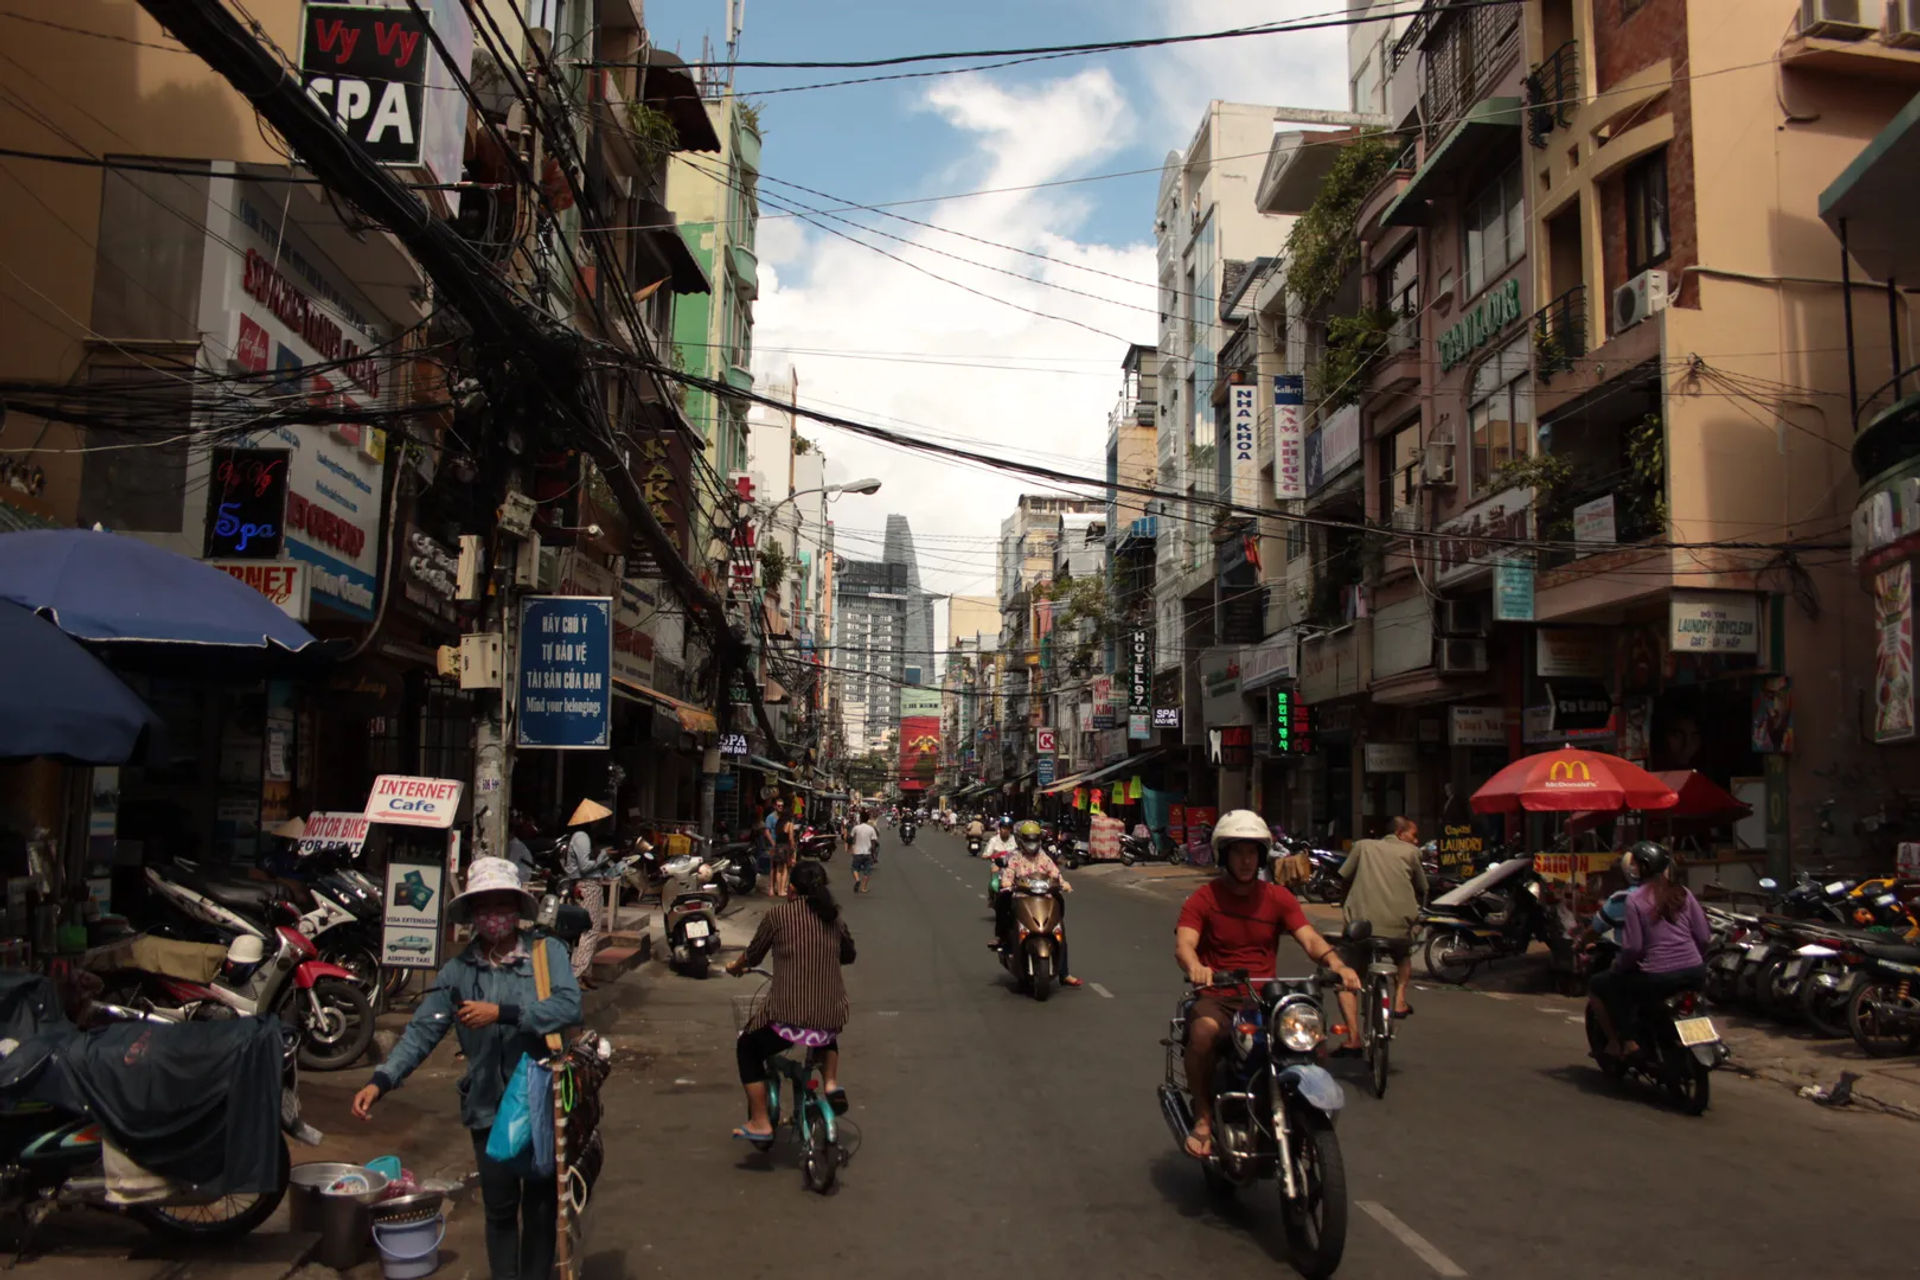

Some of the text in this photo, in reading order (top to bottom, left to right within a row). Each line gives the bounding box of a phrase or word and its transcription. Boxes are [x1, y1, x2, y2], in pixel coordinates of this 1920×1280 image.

[315, 19, 419, 67] Vy Vy
[1237, 390, 1252, 460] NHA KHOA
[215, 502, 277, 551] Spa
[562, 613, 578, 633] CHÚ
[581, 613, 587, 633] Ý
[527, 667, 601, 692] TÀI SẢN CỦA BẠN
[526, 697, 600, 717] Mind your belongings
[1096, 704, 1113, 715] KIM
[1156, 709, 1176, 718] SPA
[719, 733, 747, 746] SPA
[378, 780, 457, 800] INTERNET
[1545, 780, 1597, 788] McDonald's
[389, 798, 436, 813] Cafe
[303, 817, 368, 839] MOTOR BIKE
[1440, 837, 1482, 851] LAUNDRY
